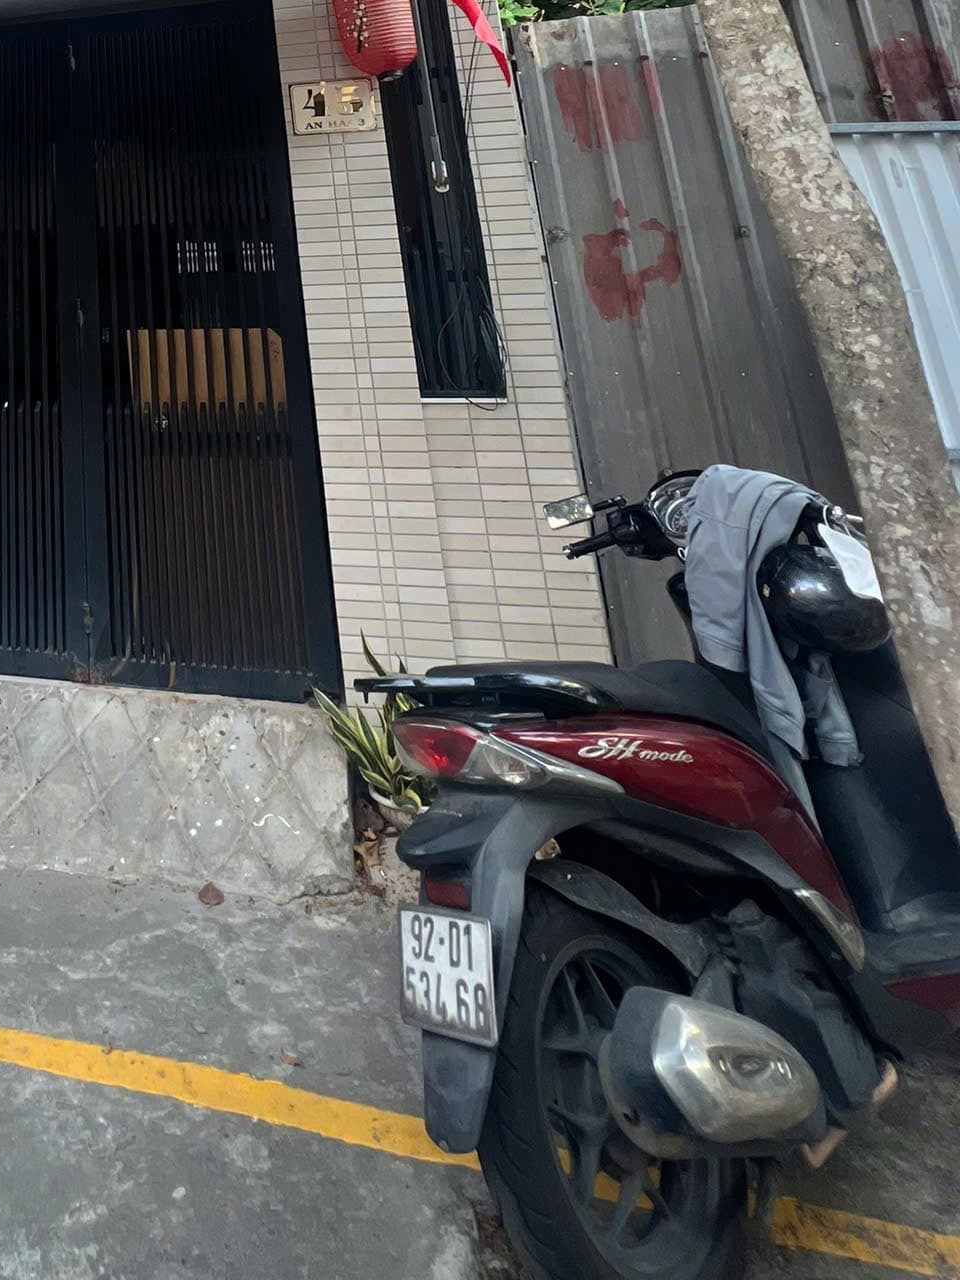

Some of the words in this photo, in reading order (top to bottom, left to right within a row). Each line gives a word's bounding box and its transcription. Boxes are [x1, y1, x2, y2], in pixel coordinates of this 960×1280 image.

[304, 120, 323, 130] AN
[578, 737, 642, 760] SH
[640, 749, 694, 764] mode
